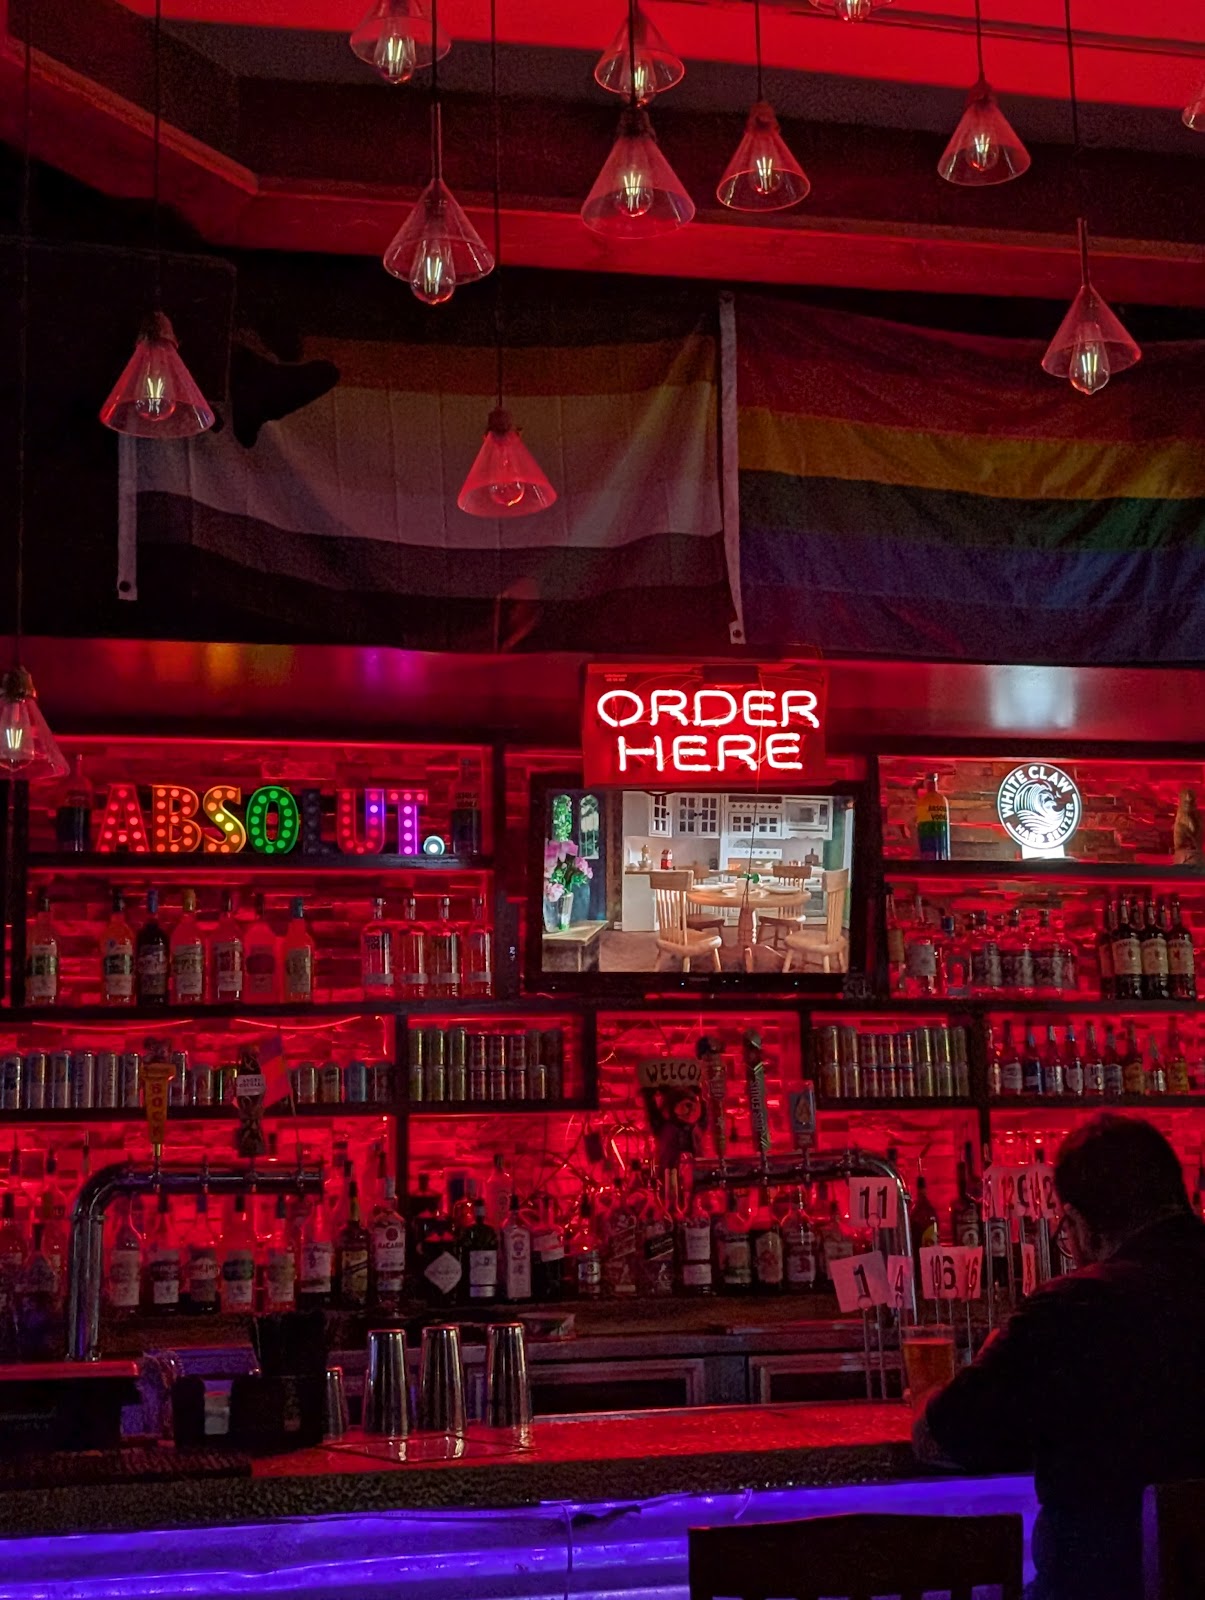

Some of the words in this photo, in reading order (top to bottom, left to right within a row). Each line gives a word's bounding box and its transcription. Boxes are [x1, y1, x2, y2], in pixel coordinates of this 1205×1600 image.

[597, 689, 820, 728] ORDER
[617, 732, 803, 771] HERE
[1000, 769, 1028, 818] WHITE
[1028, 765, 1073, 793] CLAW
[1046, 802, 1074, 843] SELTZER
[645, 1062, 702, 1083] WELCO
[859, 1185, 889, 1220] 11
[853, 1263, 871, 1296] 1
[894, 1264, 905, 1293] 4
